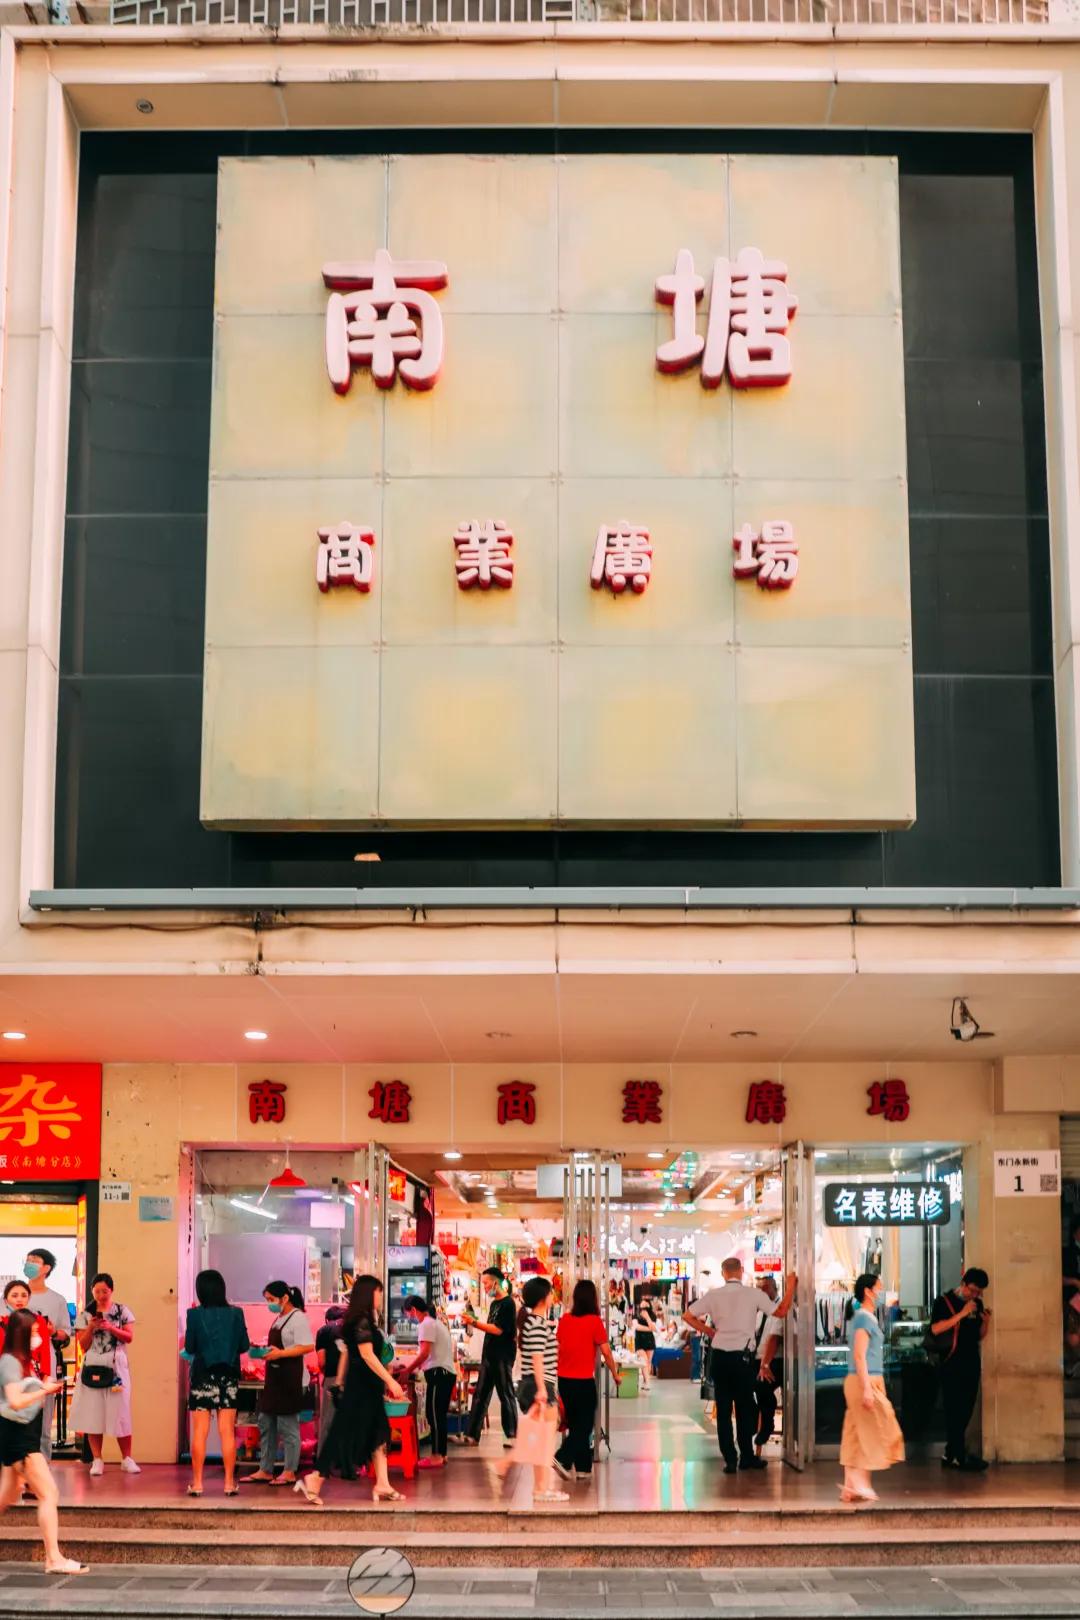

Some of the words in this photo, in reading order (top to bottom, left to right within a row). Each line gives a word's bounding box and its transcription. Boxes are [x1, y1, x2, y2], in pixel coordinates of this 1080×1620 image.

[322, 246, 797, 395] 南塘
[316, 519, 798, 594] 商業廣場
[0, 1074, 82, 1147] 杂
[248, 1080, 911, 1123] 南塘商業廣場
[833, 1186, 944, 1222] 名表维修
[1014, 1175, 1024, 1192] 1
